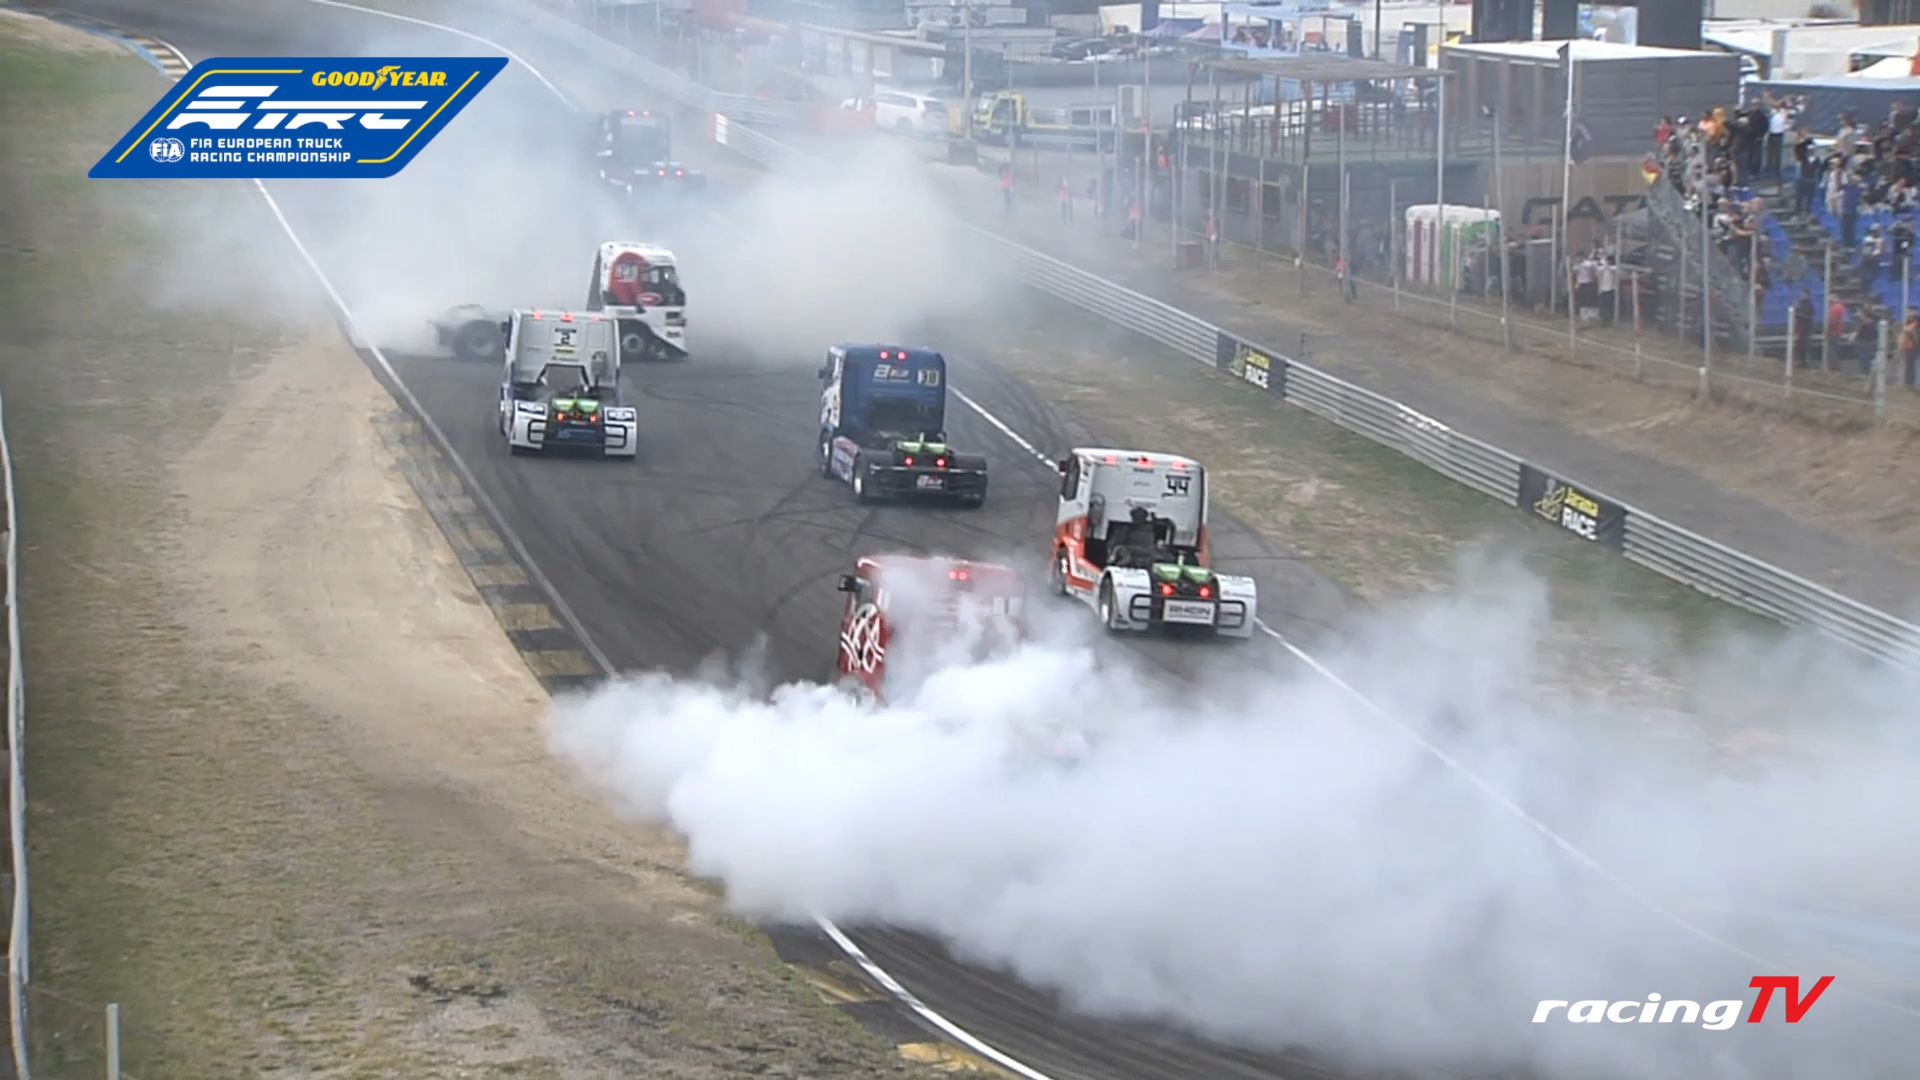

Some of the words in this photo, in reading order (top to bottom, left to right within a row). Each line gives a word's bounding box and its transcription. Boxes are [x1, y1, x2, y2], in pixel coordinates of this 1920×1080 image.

[561, 332, 571, 345] 2
[1245, 364, 1268, 389] RACE
[1167, 479, 1189, 495] 44
[1562, 506, 1597, 540] RACE
